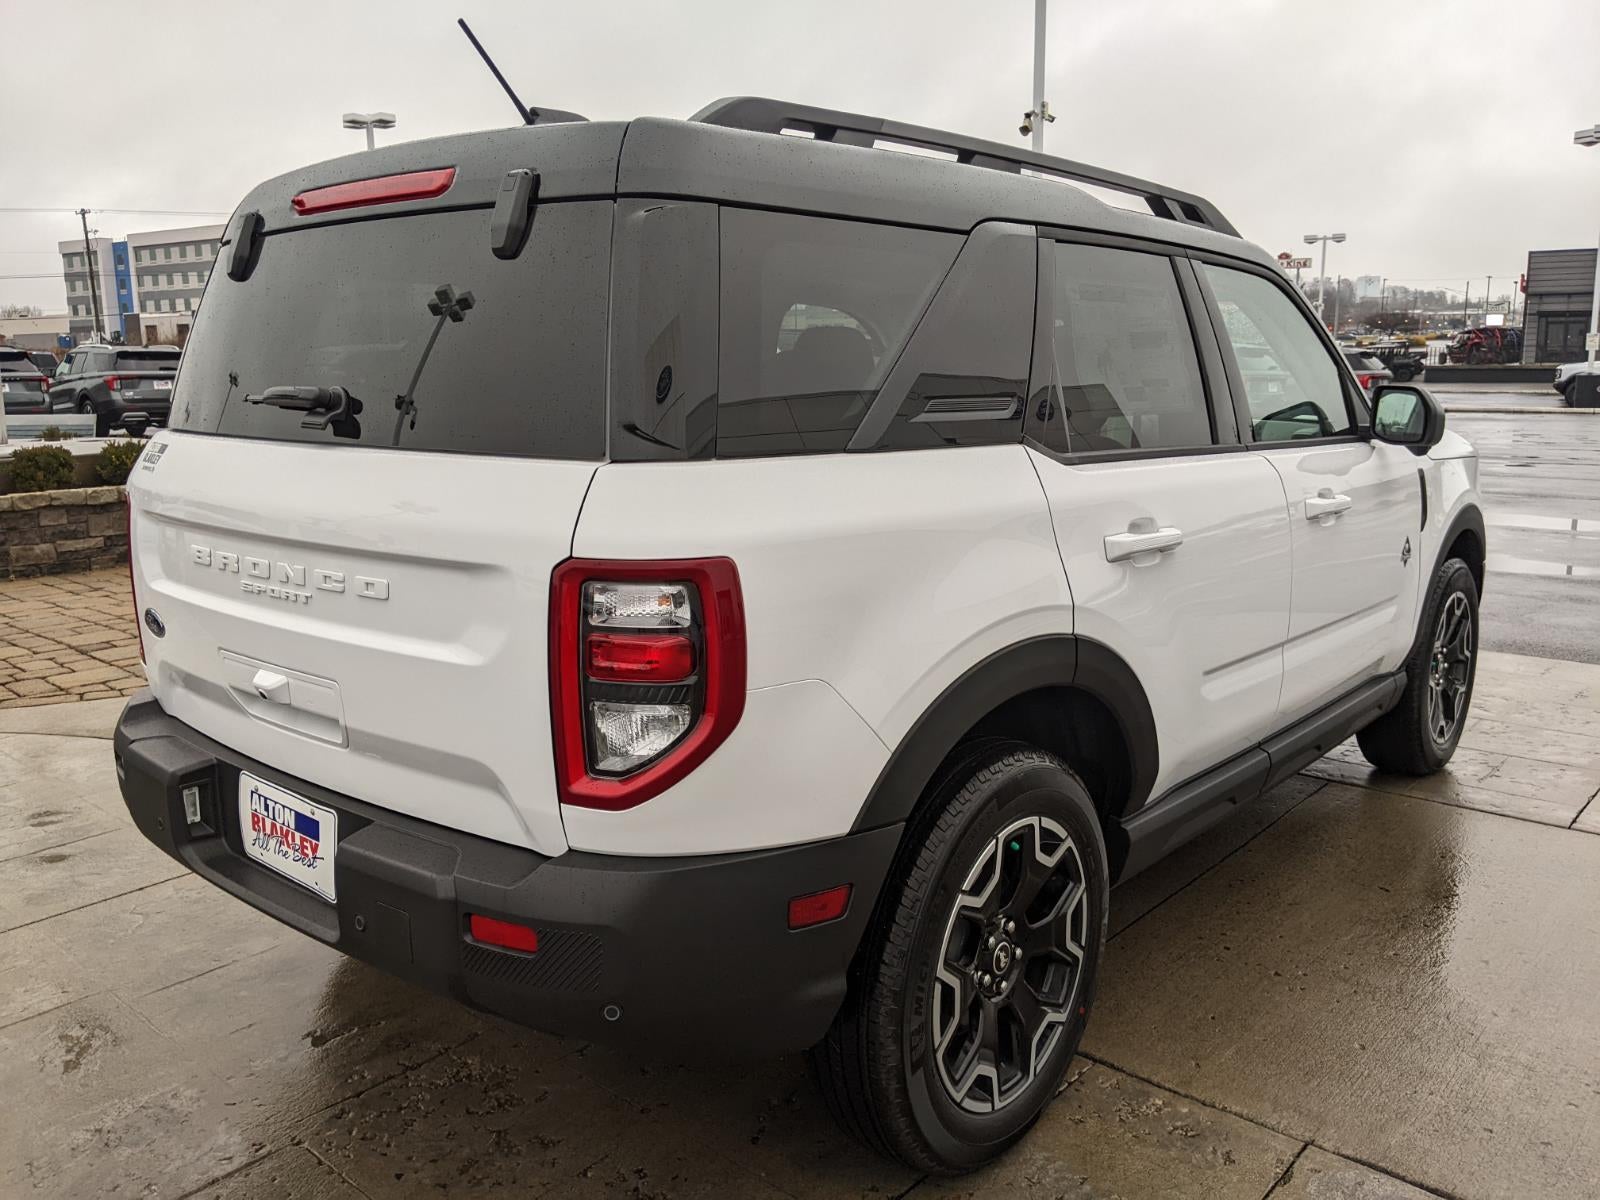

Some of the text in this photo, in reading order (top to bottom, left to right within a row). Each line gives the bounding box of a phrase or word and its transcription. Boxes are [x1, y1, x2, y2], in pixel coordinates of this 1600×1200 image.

[190, 544, 390, 601] BRONCO
[240, 580, 313, 605] SPORT
[250, 792, 296, 830] ALTON
[251, 811, 320, 858] BLAKLEY
[252, 829, 325, 869] All The Best
